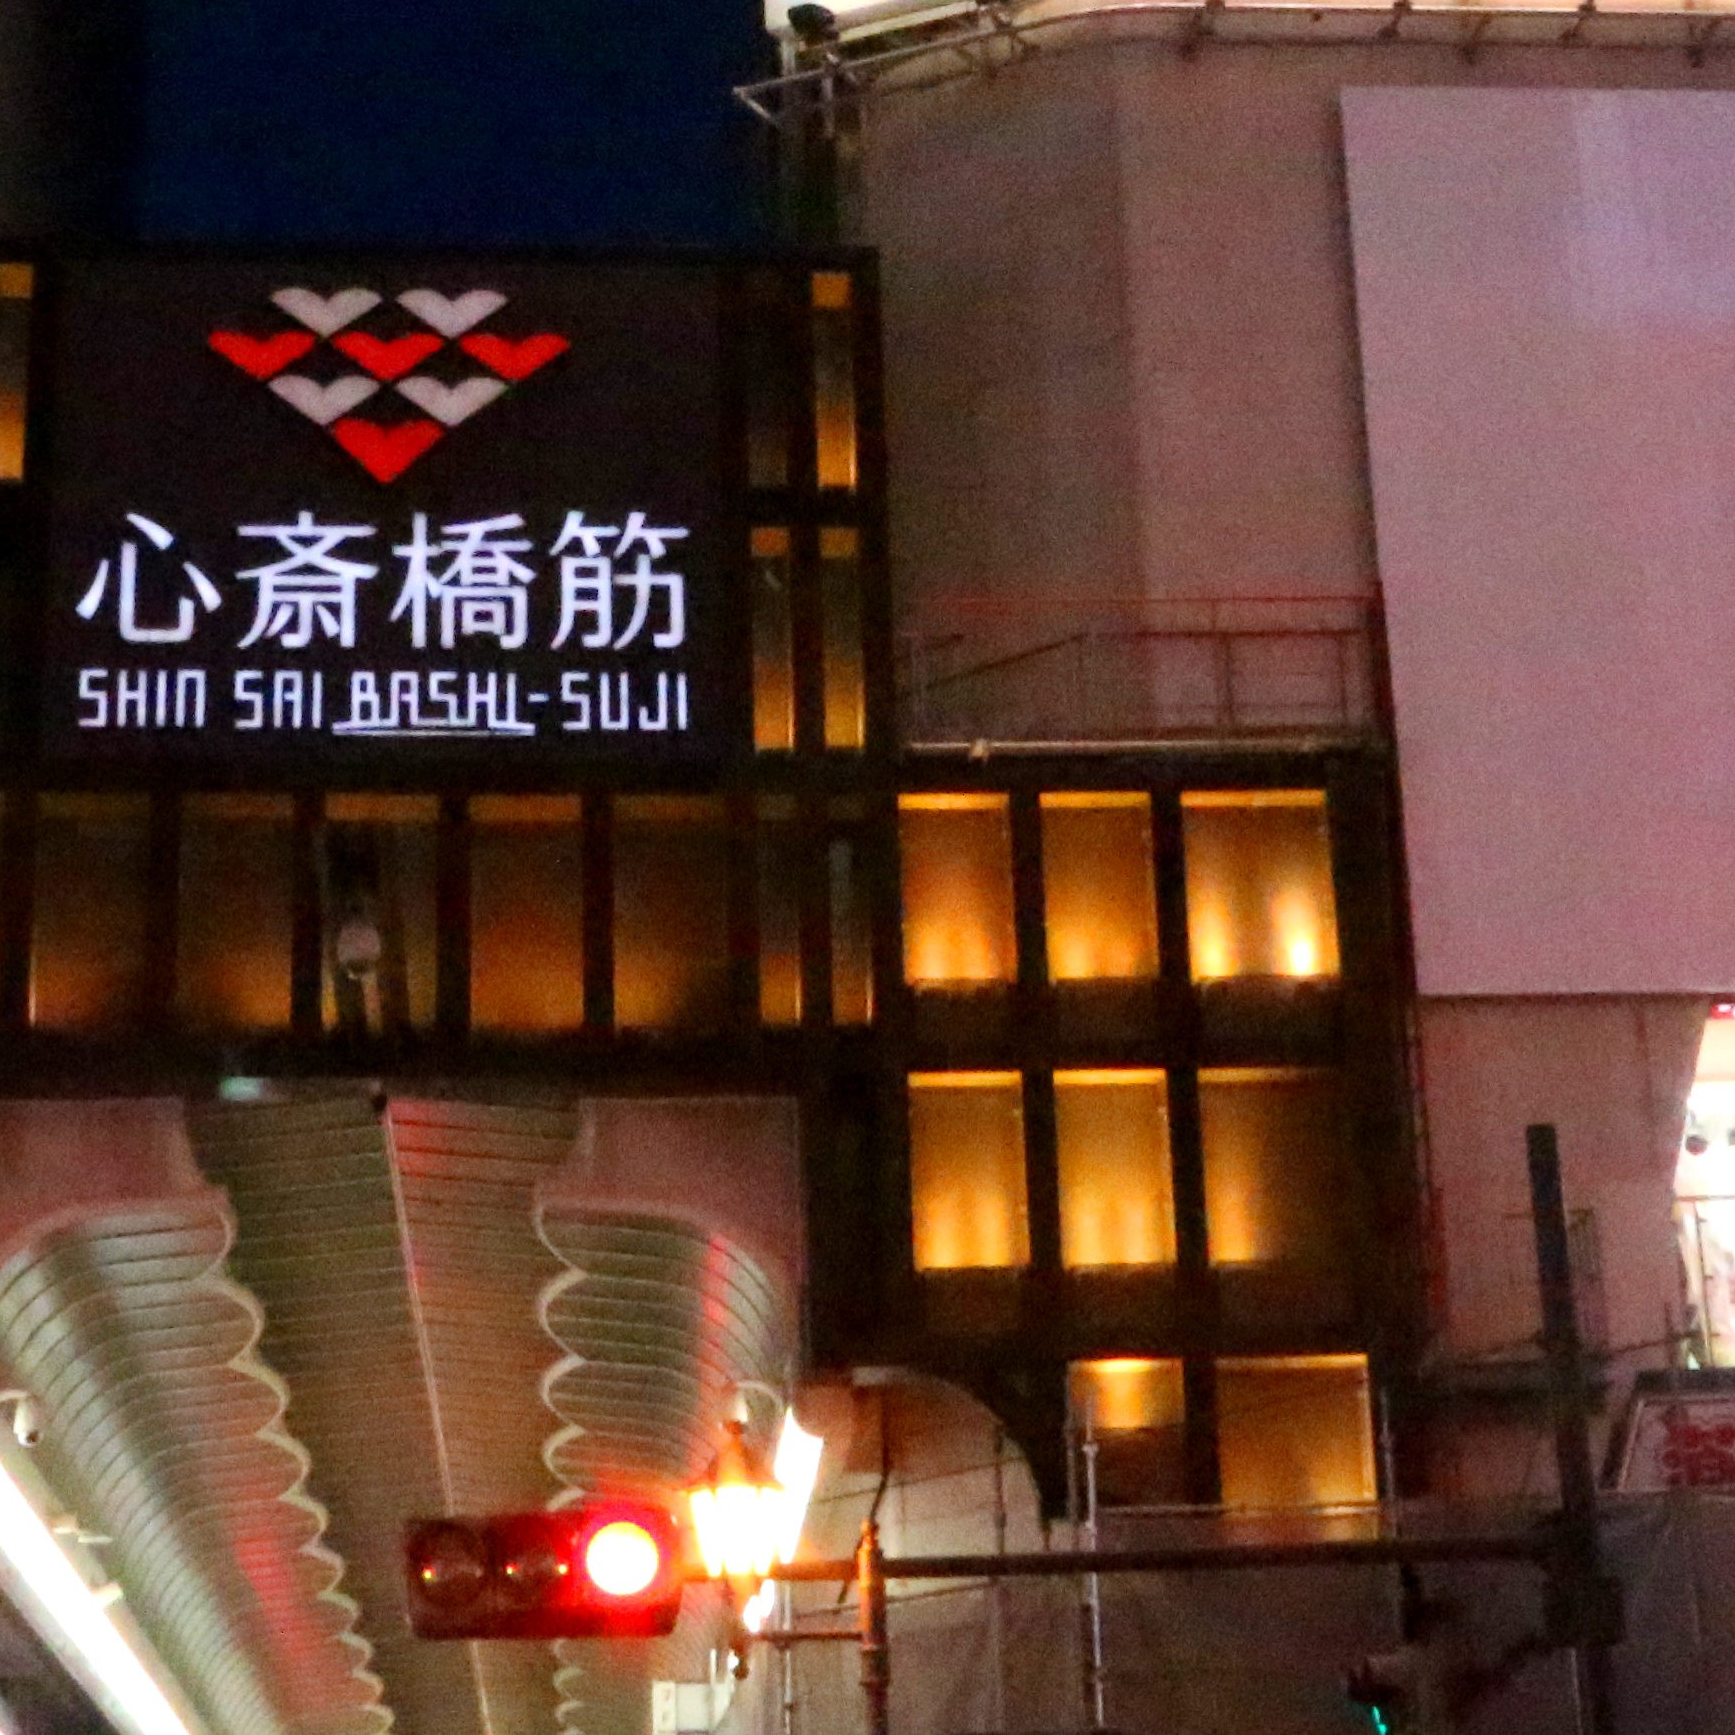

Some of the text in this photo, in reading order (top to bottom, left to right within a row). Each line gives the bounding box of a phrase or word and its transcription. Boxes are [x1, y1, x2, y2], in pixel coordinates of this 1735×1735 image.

[75, 510, 691, 652] 心斎橋筋
[77, 668, 208, 730] SHIN
